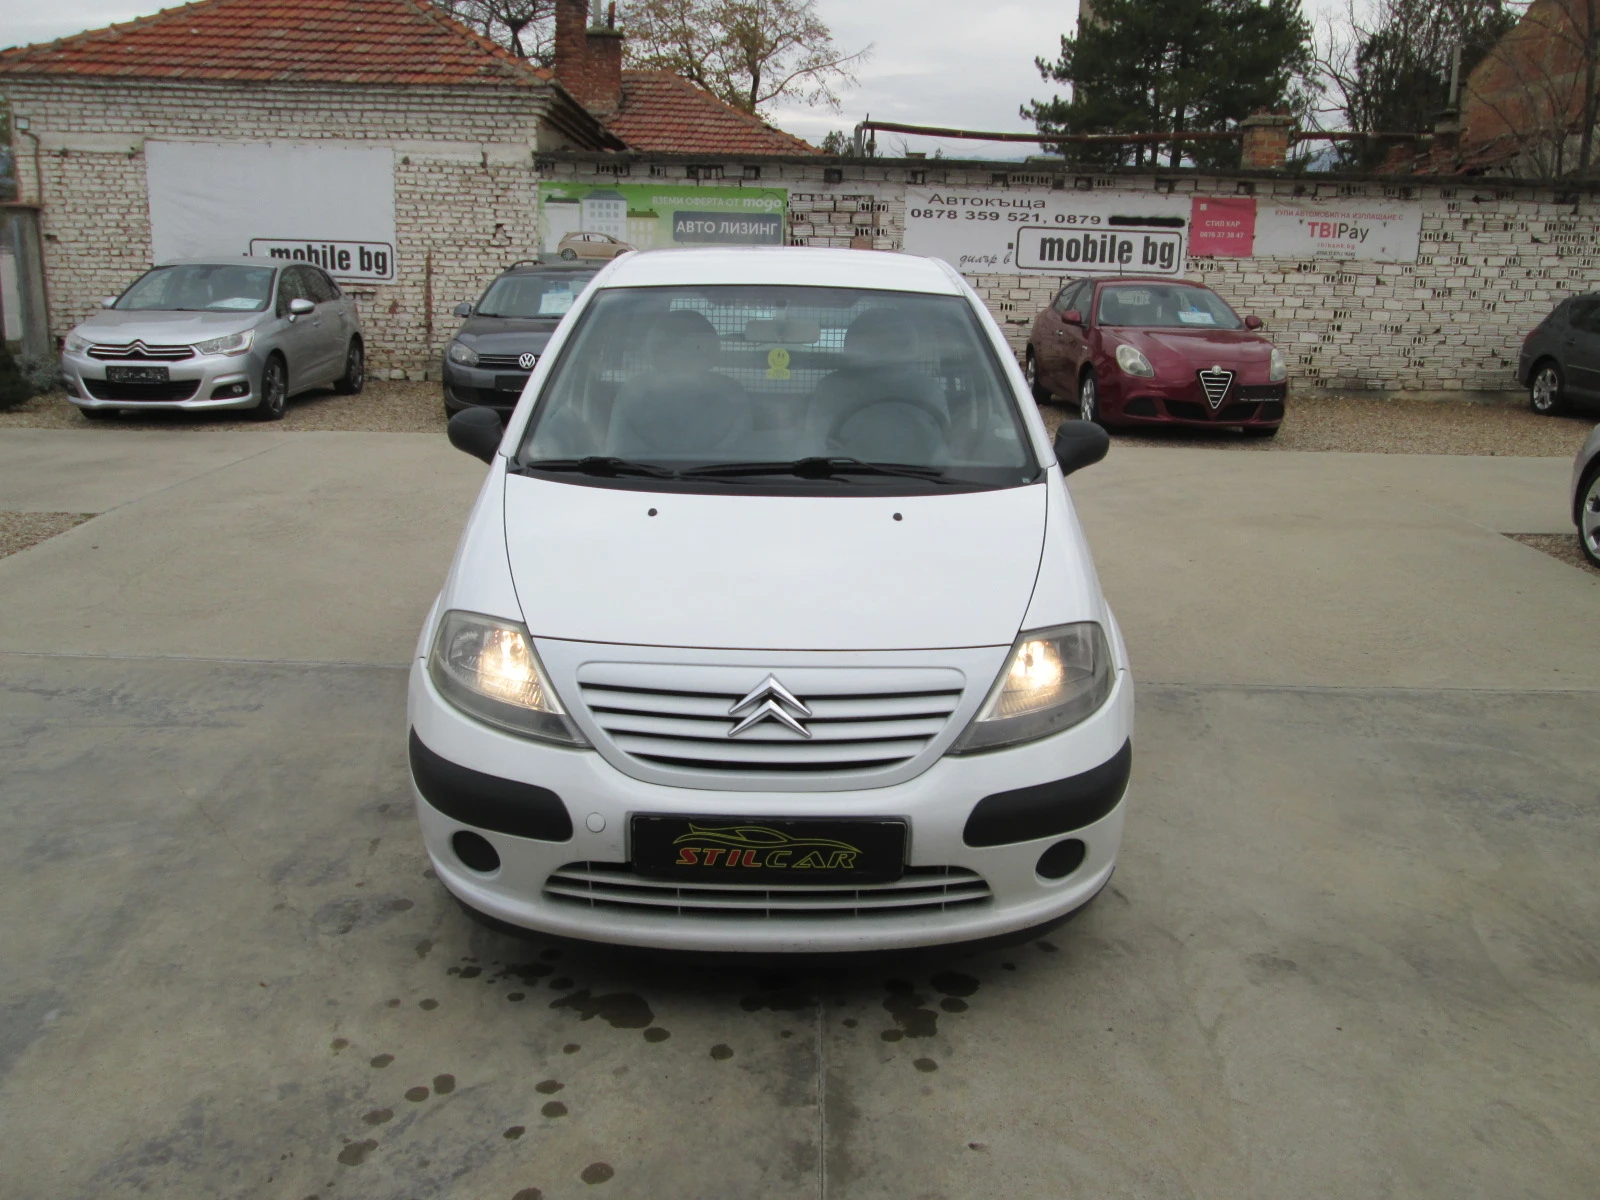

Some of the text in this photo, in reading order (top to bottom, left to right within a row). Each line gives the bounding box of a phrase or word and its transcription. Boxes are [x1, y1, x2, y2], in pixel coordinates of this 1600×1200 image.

[652, 196, 782, 211] ВЗЕМИ ОФЕРТА ОТ mogo
[928, 193, 1046, 210] Автокъща
[910, 208, 1101, 225] 0878 359 521, 0879
[1205, 219, 1241, 228] СТИЛ КАР
[1295, 210, 1340, 218] АВТОМОБИЛ
[1352, 212, 1397, 221] ИЗПЛАЩАНЕ
[676, 220, 778, 236] АВТО ЛИЗИНГ
[1307, 221, 1370, 244] TBIPay
[1039, 234, 1175, 269] mobile bg
[359, 246, 388, 276] bg
